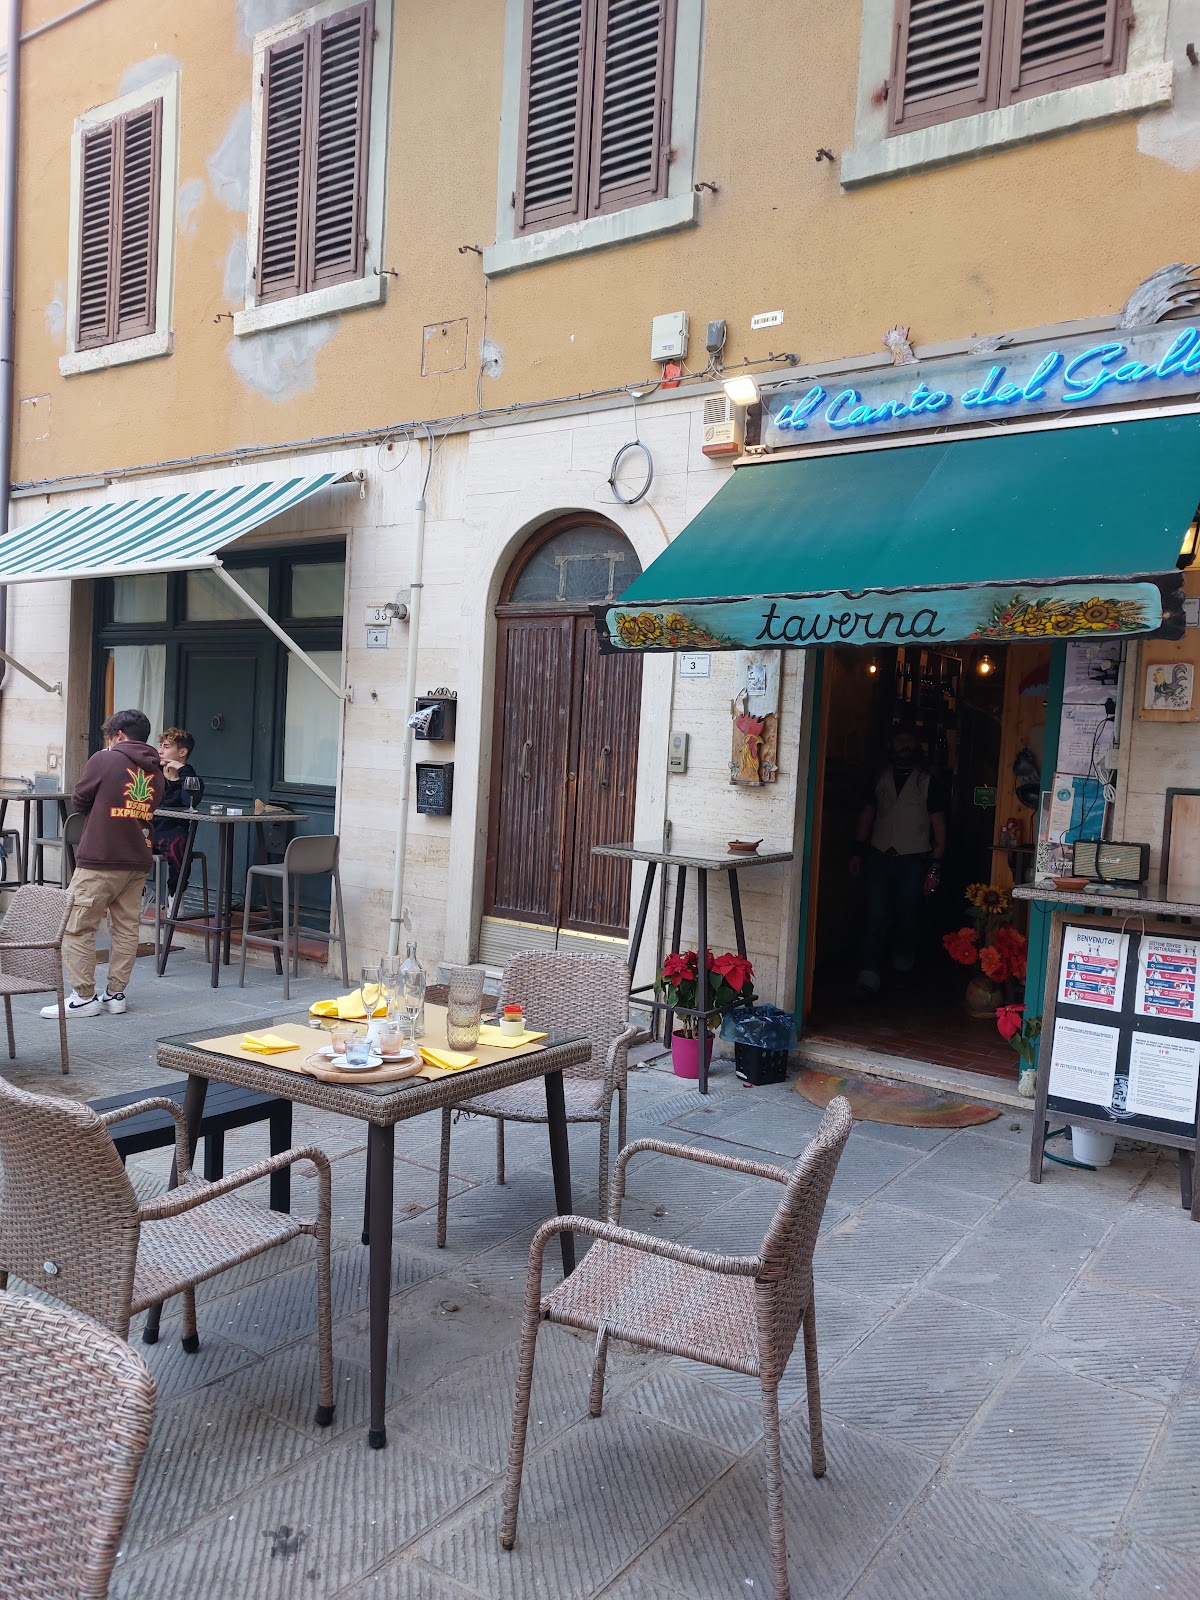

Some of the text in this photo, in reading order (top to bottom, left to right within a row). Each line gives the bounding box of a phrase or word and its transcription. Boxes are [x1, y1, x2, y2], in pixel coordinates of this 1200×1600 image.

[823, 381, 953, 430] Canto
[960, 351, 1064, 408] del
[755, 602, 946, 642] taverna
[690, 661, 696, 670] 3
[1076, 933, 1115, 945] BENVENUTO!
